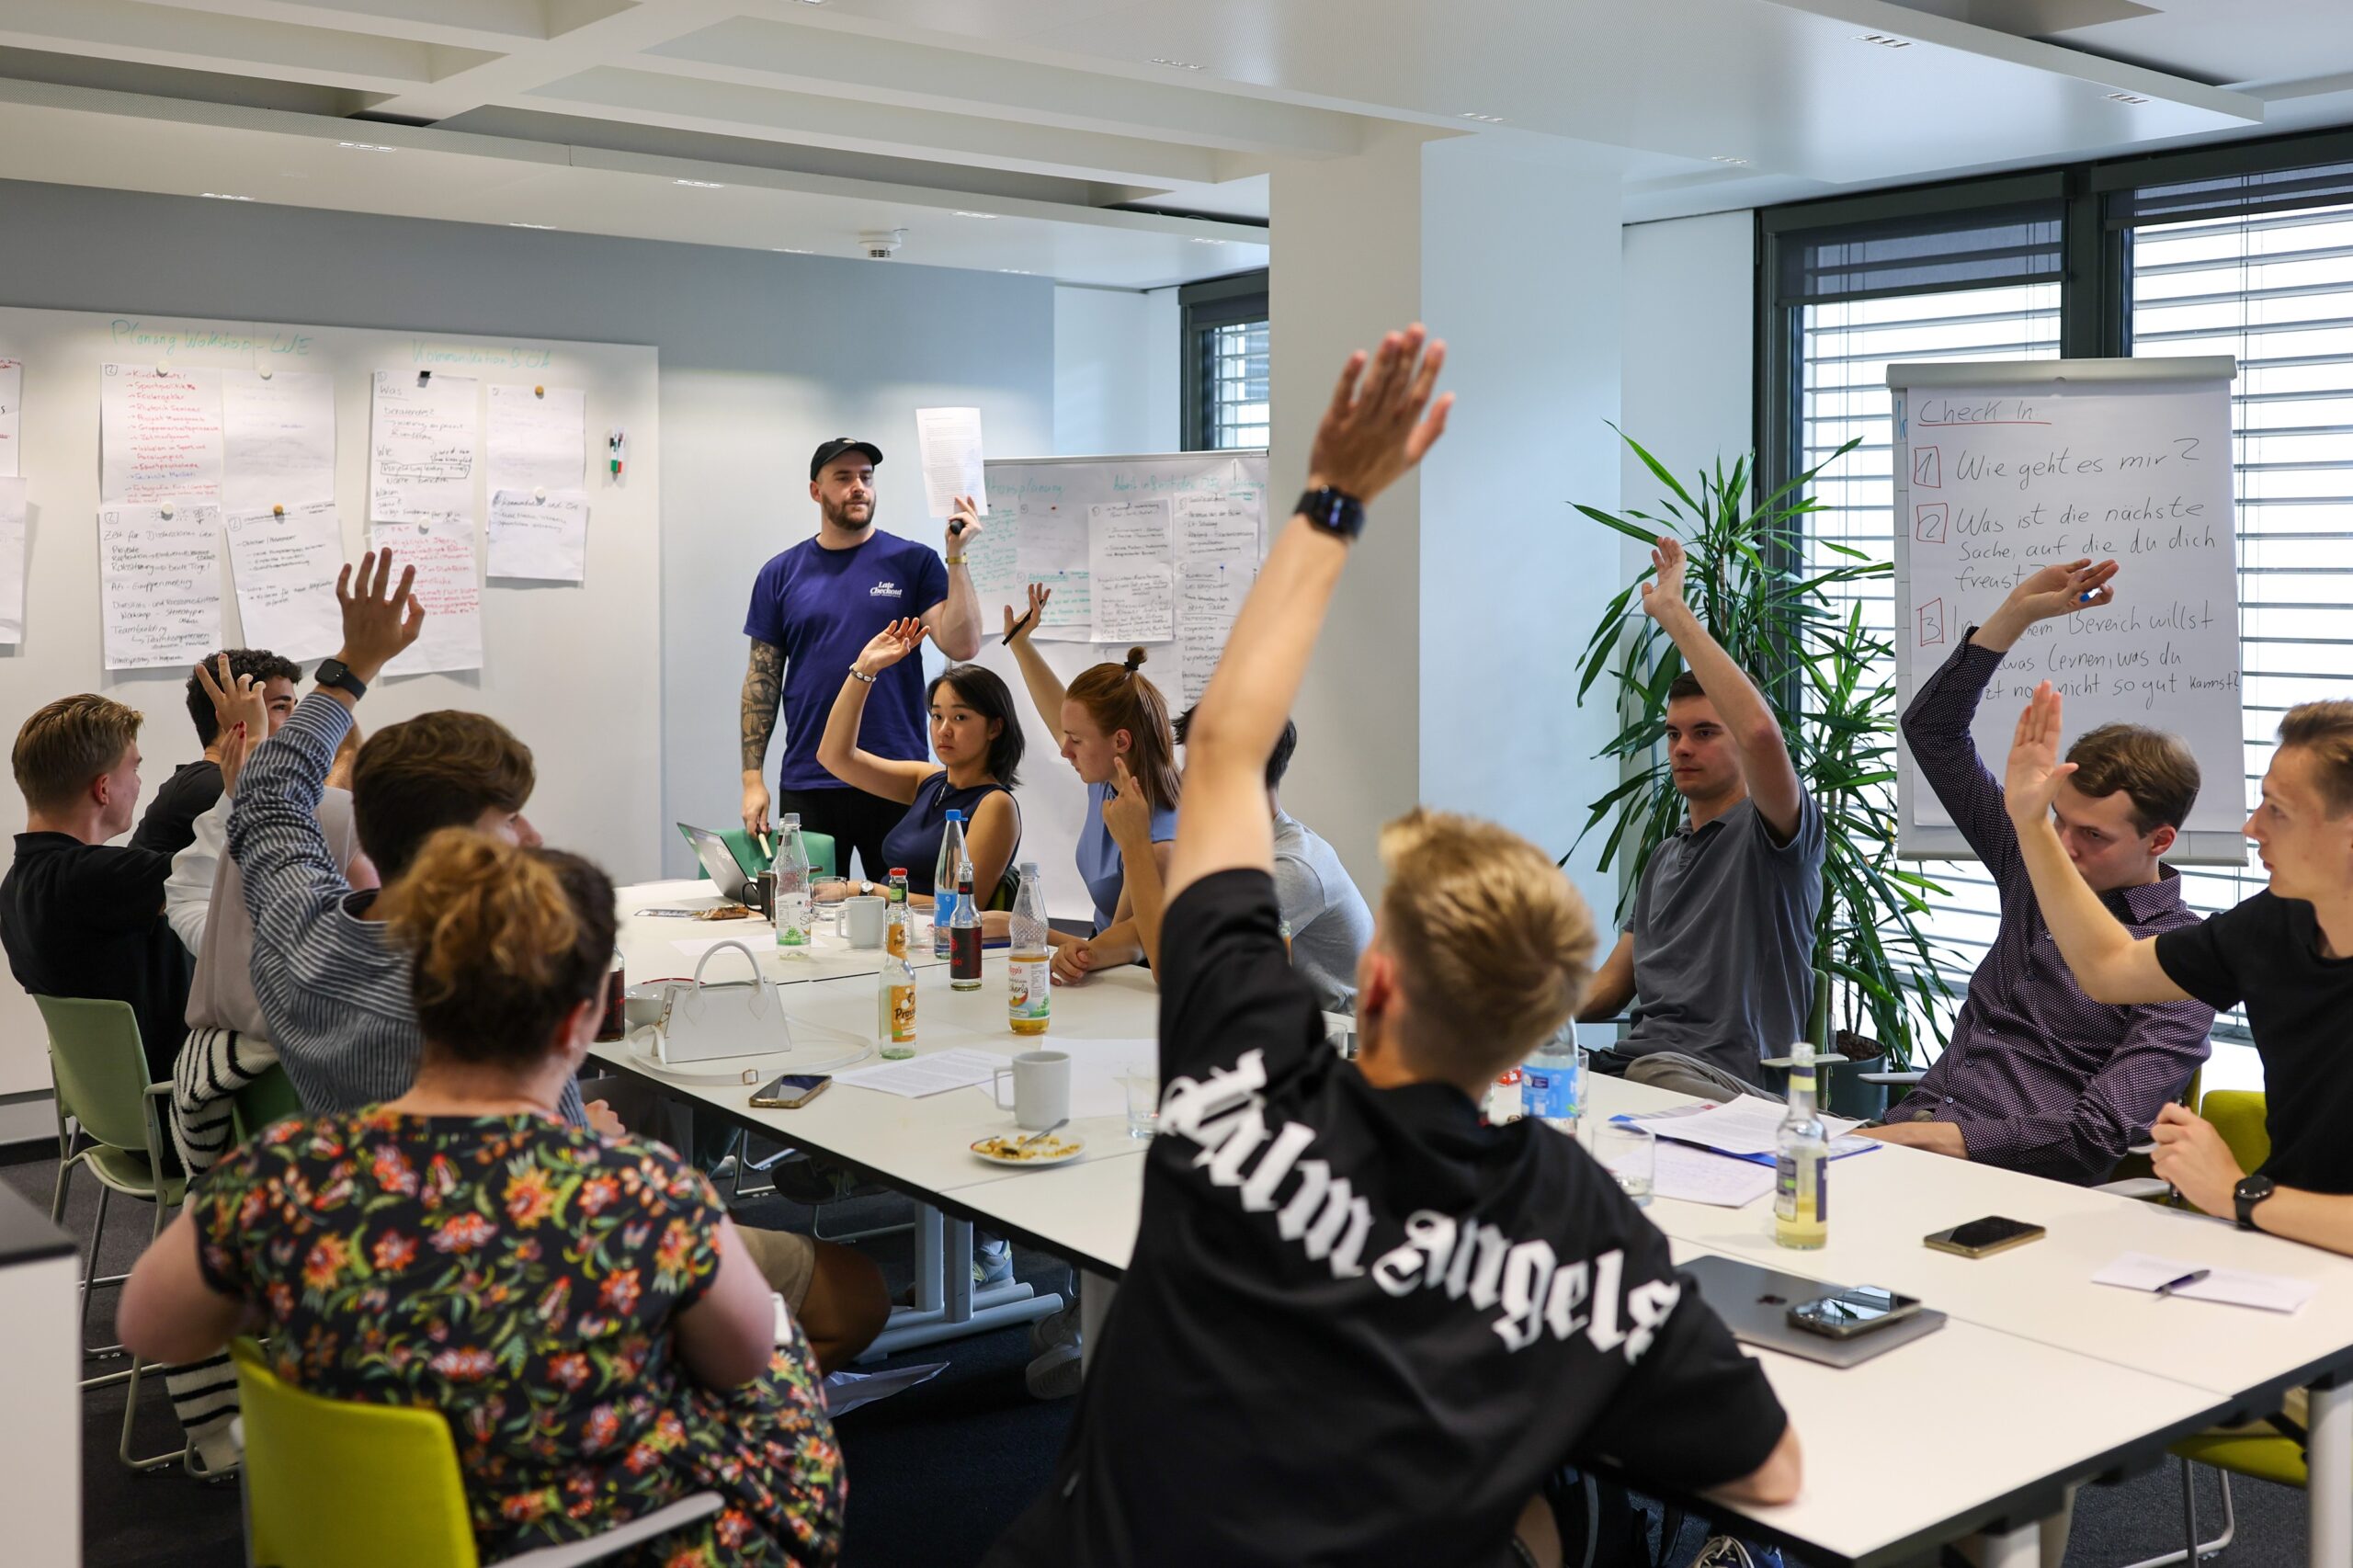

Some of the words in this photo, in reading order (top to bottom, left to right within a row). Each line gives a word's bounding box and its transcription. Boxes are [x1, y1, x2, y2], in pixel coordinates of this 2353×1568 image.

[1920, 399, 2003, 425] Check
[1957, 449, 2008, 481] Wie
[2018, 446, 2073, 491] geht
[2075, 456, 2105, 474] es
[1956, 507, 2005, 536] Was
[2018, 502, 2049, 529] ist
[2060, 504, 2091, 525] die
[2104, 494, 2206, 523] nächste
[1958, 540, 2016, 562] Sache,
[2025, 534, 2070, 557] auf
[2082, 533, 2119, 554] die
[2130, 527, 2158, 554] du
[2168, 524, 2216, 550] dich
[2068, 605, 2141, 636] Bereich
[2149, 599, 2214, 631] willst
[1996, 655, 2036, 672] was
[2117, 649, 2150, 667] was
[2159, 641, 2182, 666] du
[2057, 672, 2100, 697] nicht
[2112, 677, 2136, 697] so
[2142, 672, 2177, 711] gut
[1372, 1208, 1682, 1366] Angels
